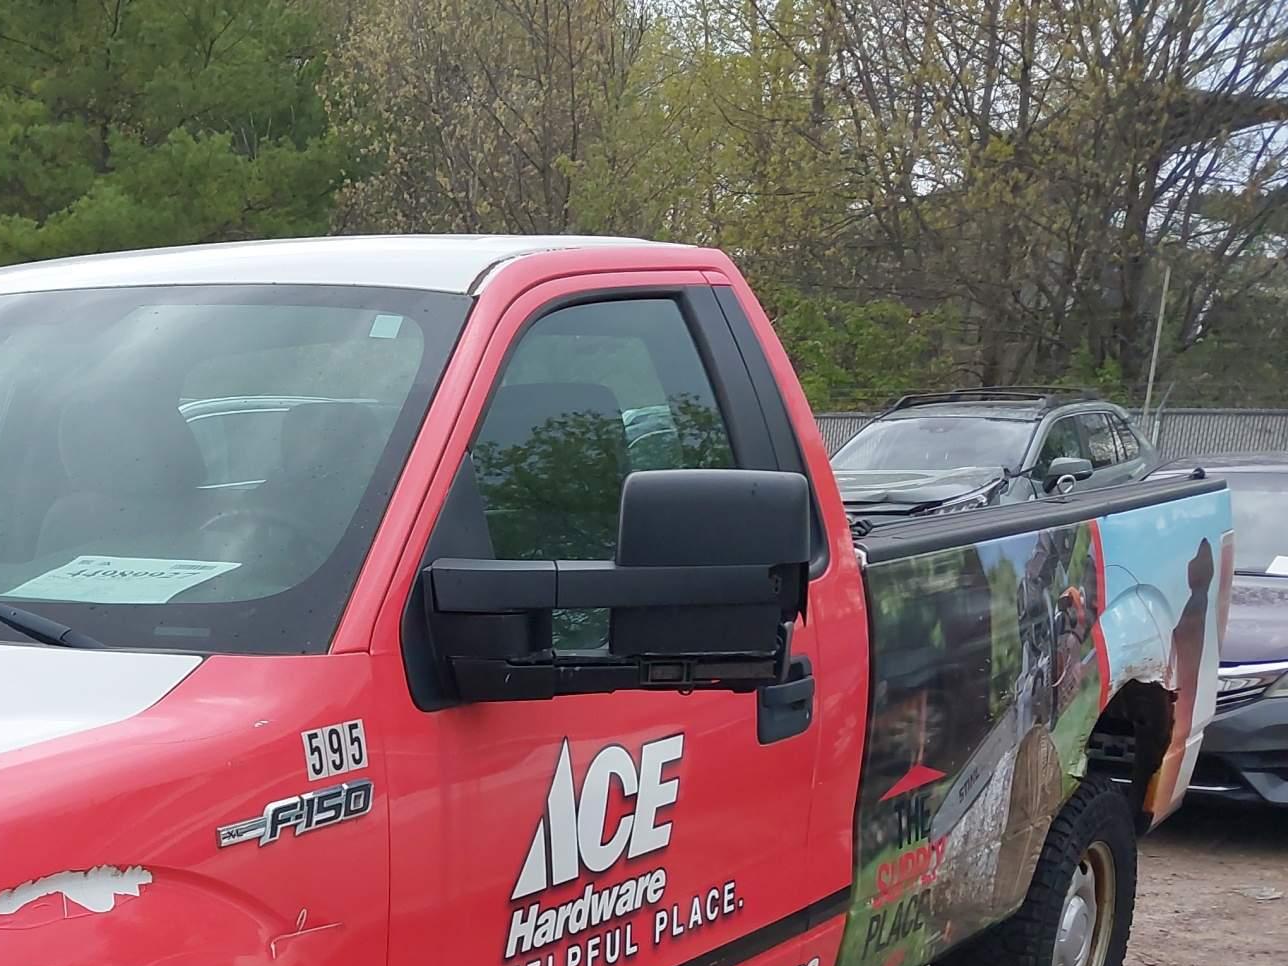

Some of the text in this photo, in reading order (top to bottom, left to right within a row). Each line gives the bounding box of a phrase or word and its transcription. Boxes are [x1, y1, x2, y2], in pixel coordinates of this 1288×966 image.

[306, 722, 364, 776] 595
[265, 780, 373, 841] F-150
[511, 734, 685, 900] ACE
[894, 795, 932, 850] THE
[505, 868, 667, 959] Hardware
[654, 882, 744, 943] PLACE.
